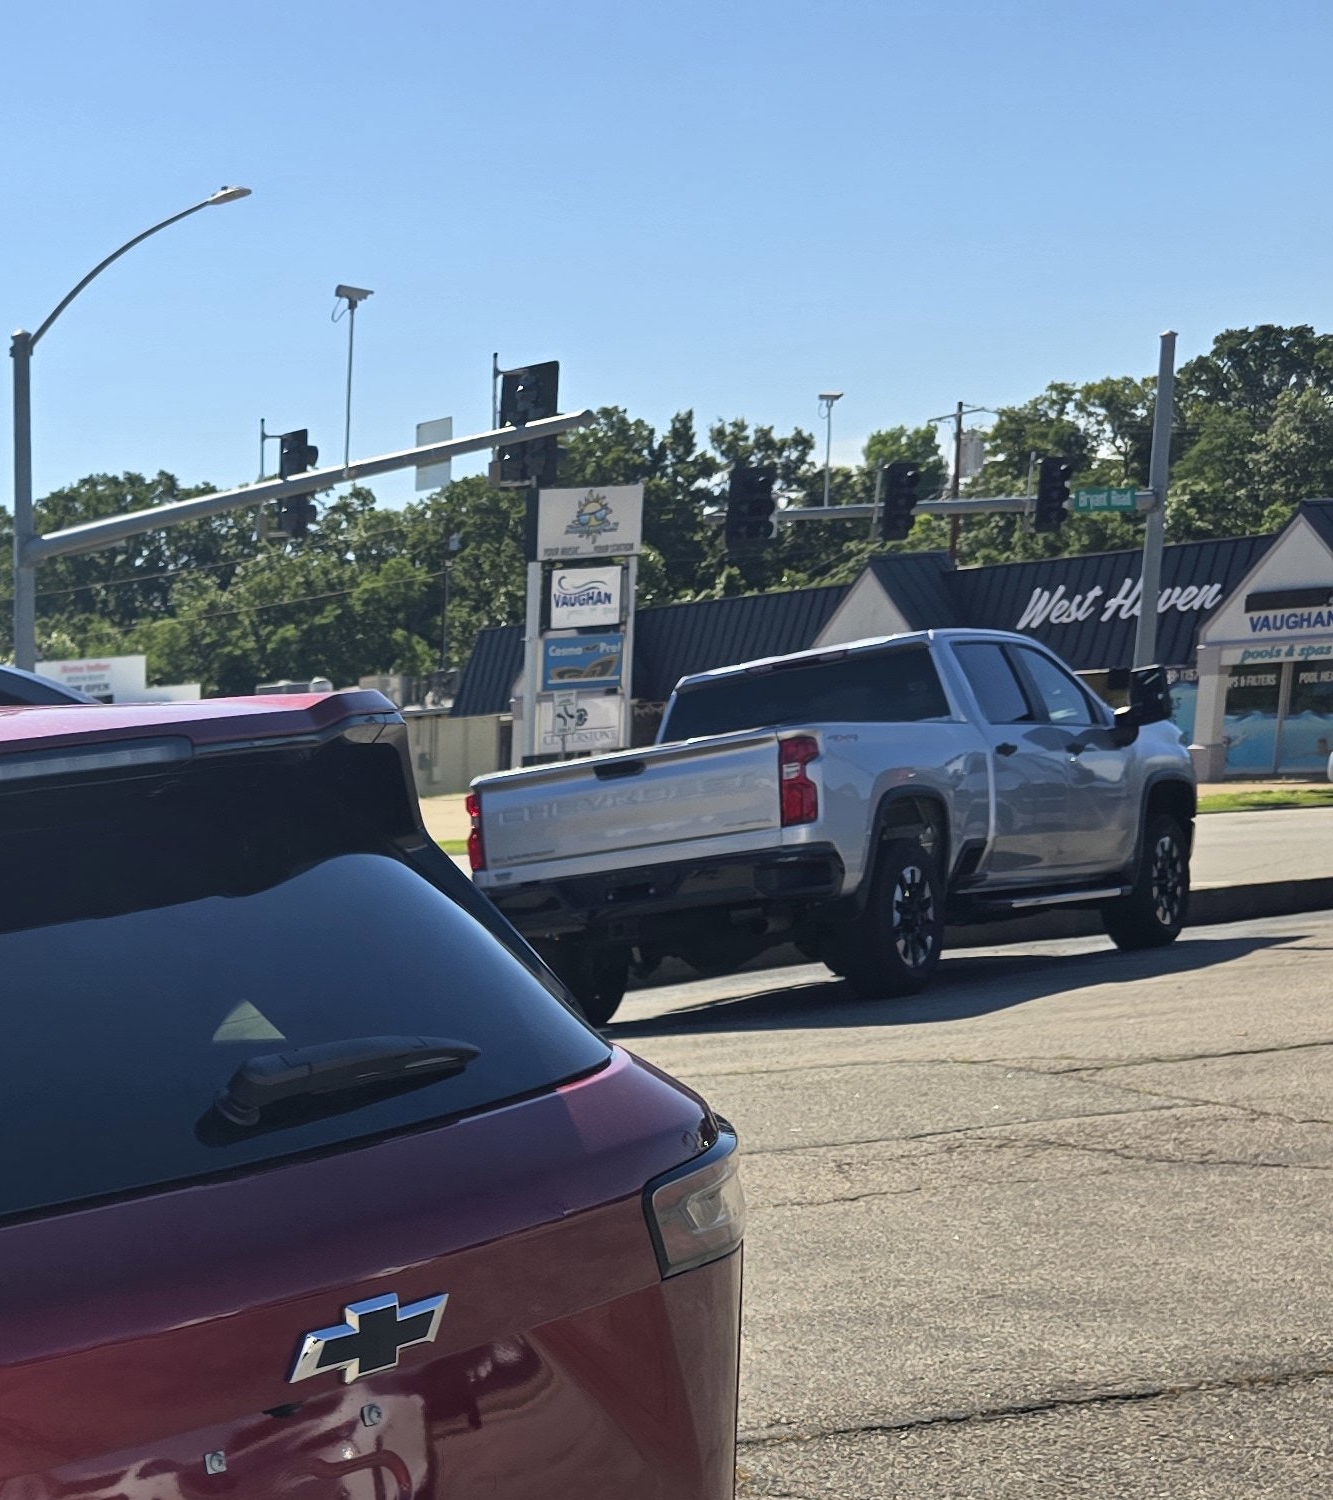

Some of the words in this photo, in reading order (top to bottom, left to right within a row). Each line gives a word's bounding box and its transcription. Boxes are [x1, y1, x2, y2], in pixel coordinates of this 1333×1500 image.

[553, 591, 612, 608] VAUGHAN
[1016, 585, 1103, 630] West
[1100, 578, 1222, 622] Hven
[1240, 646, 1282, 664] pools
[1298, 645, 1332, 660] spas
